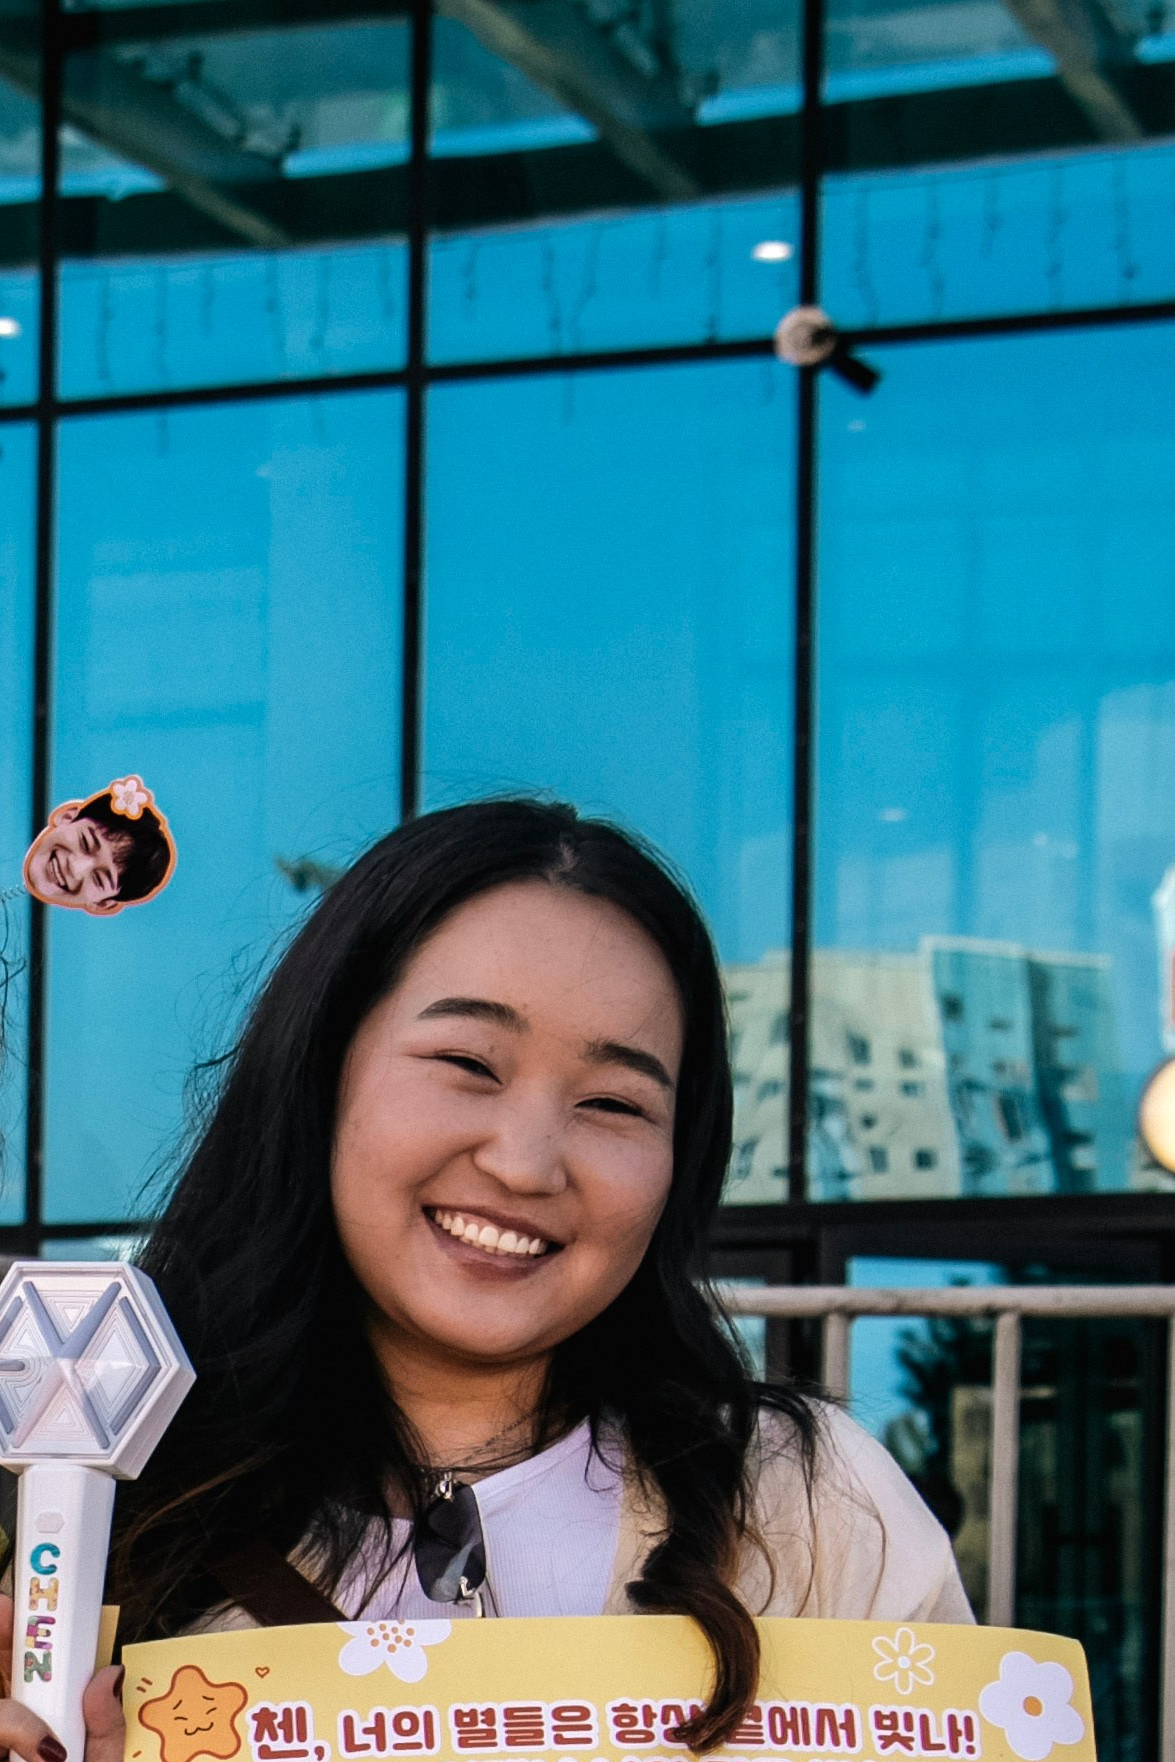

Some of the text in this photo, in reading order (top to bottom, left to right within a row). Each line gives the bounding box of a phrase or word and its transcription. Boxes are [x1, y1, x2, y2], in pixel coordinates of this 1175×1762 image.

[23, 1541, 61, 1683] CHEN
[250, 1705, 327, 1762] 첸,
[340, 1709, 437, 1756] 너의
[451, 1703, 594, 1751] 별들은
[871, 1709, 977, 1757] 빛나!
